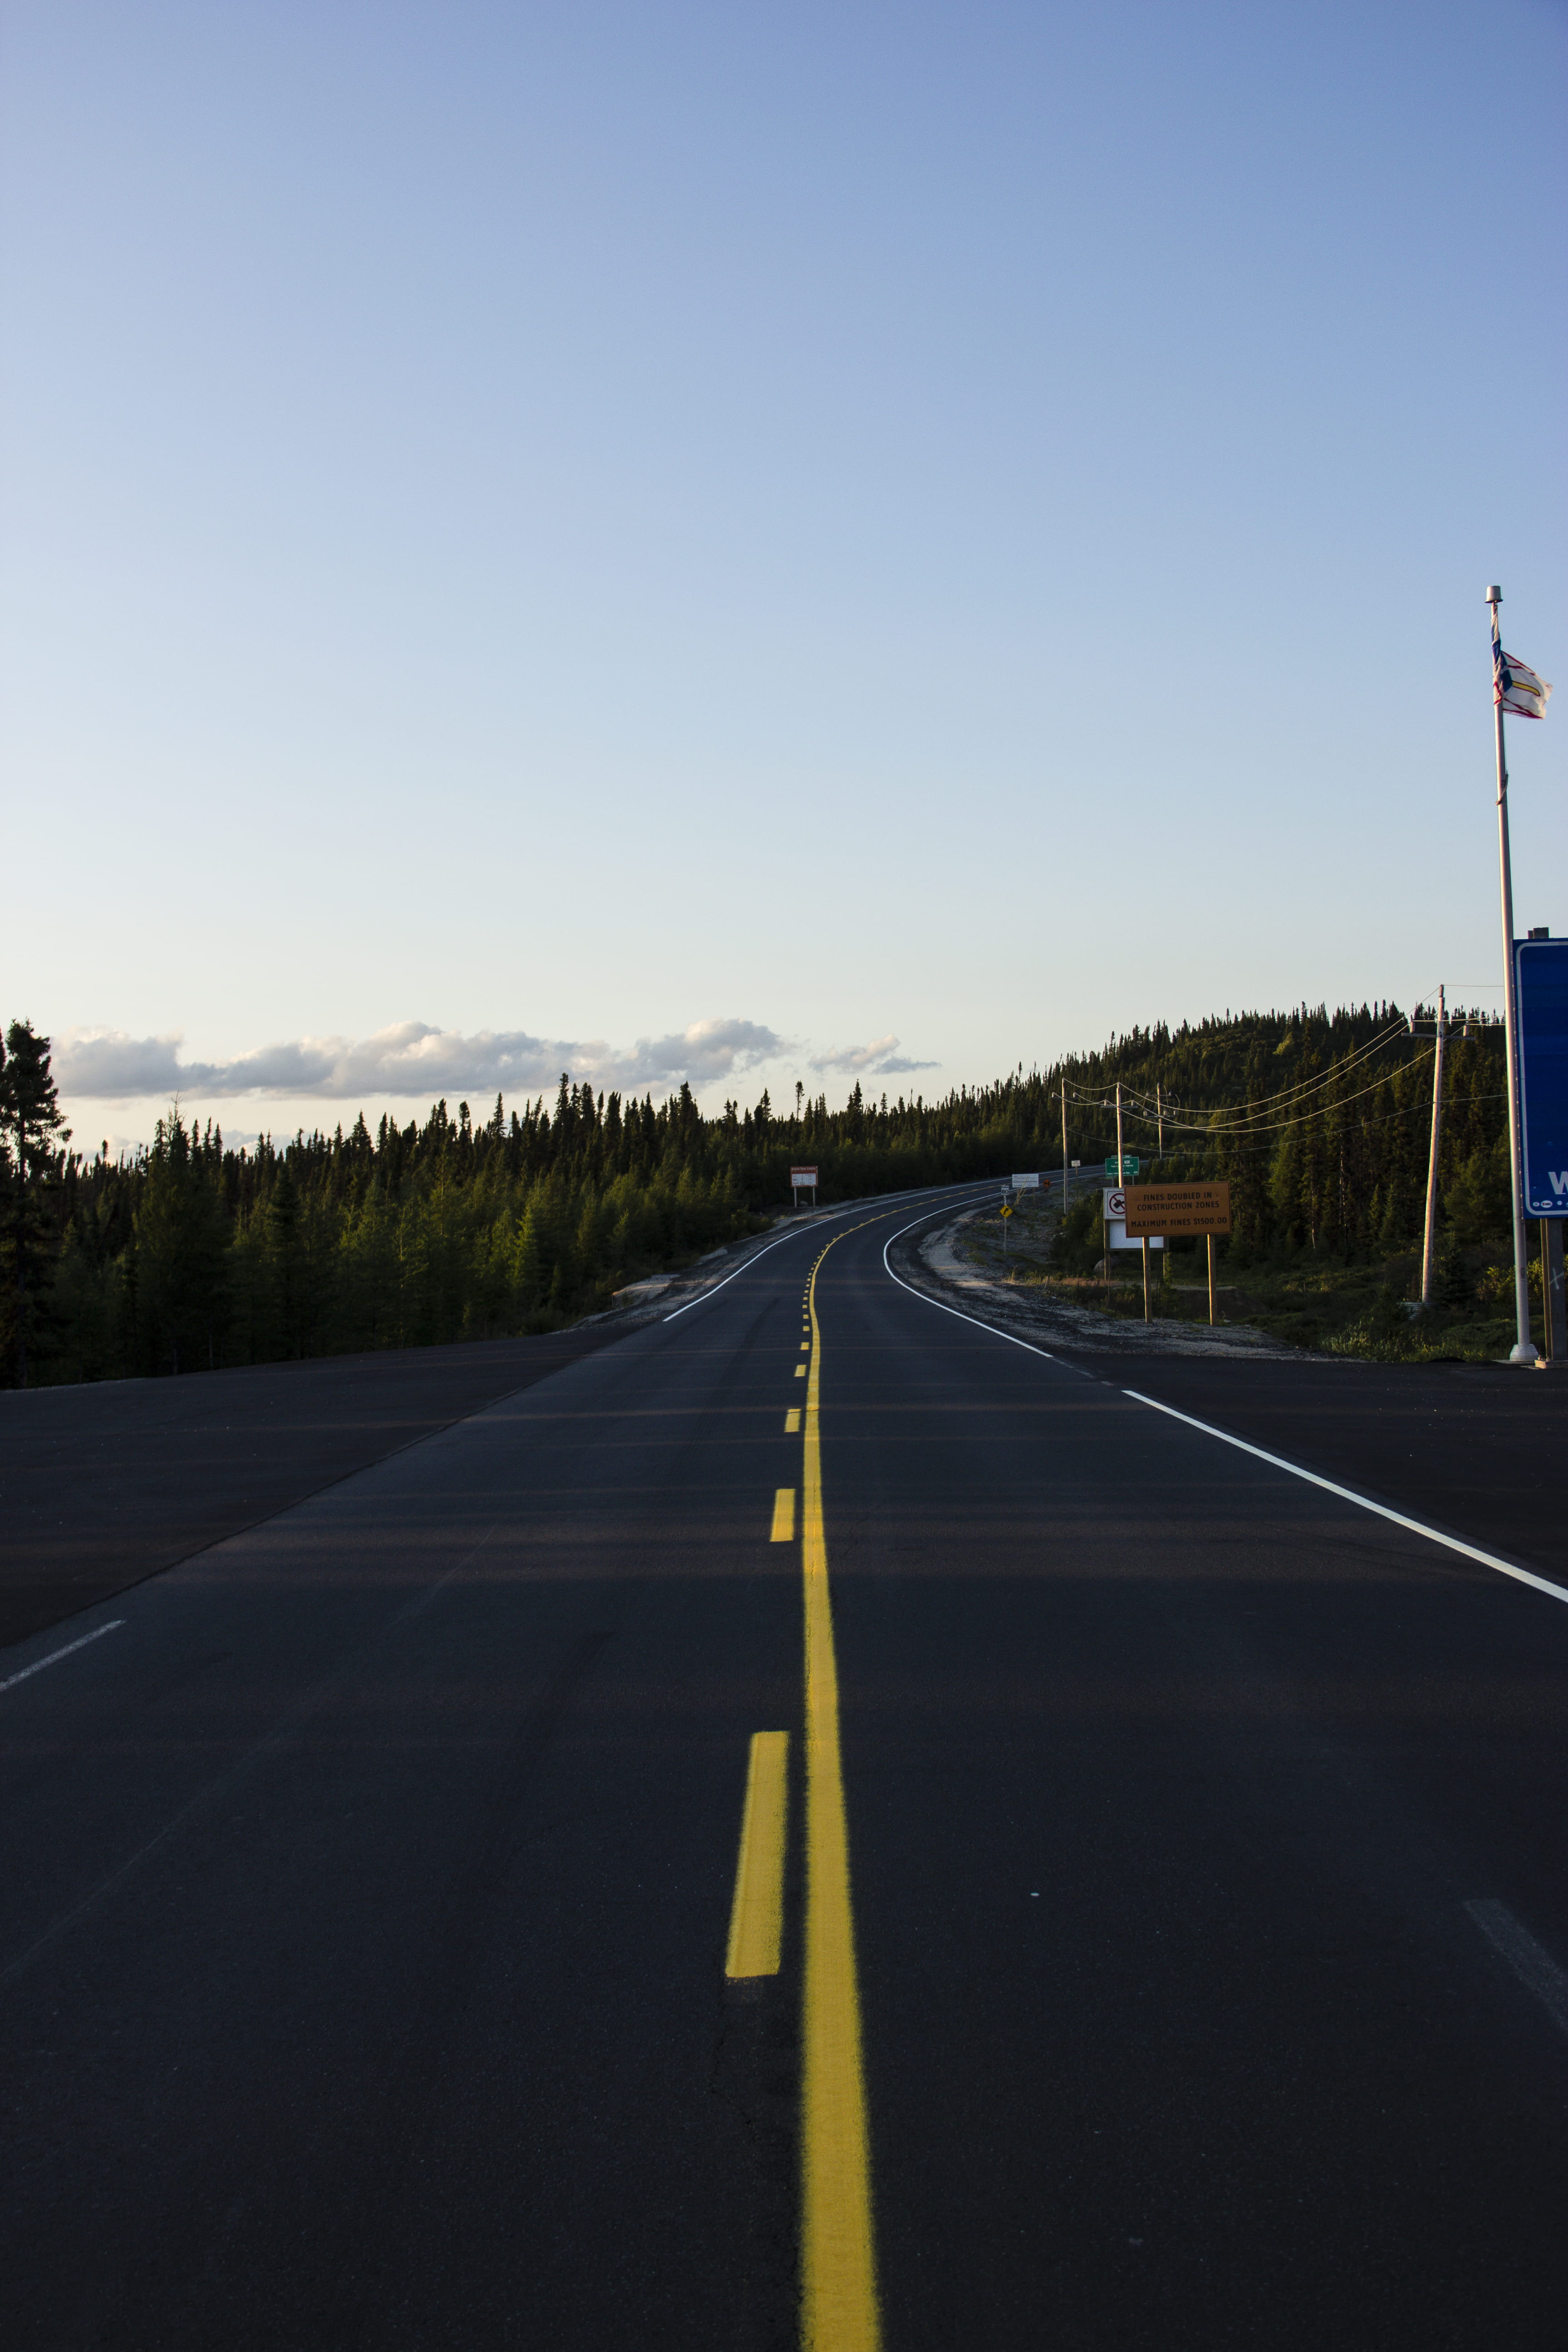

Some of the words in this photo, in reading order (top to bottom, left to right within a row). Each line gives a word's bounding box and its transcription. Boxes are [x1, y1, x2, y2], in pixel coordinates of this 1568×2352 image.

[1167, 1192, 1200, 1200] DOUBLED
[1137, 1202, 1192, 1211] CONSTRUCTION
[1131, 1220, 1167, 1228] MAXIMUM
[1194, 1217, 1227, 1225] $1500.00
